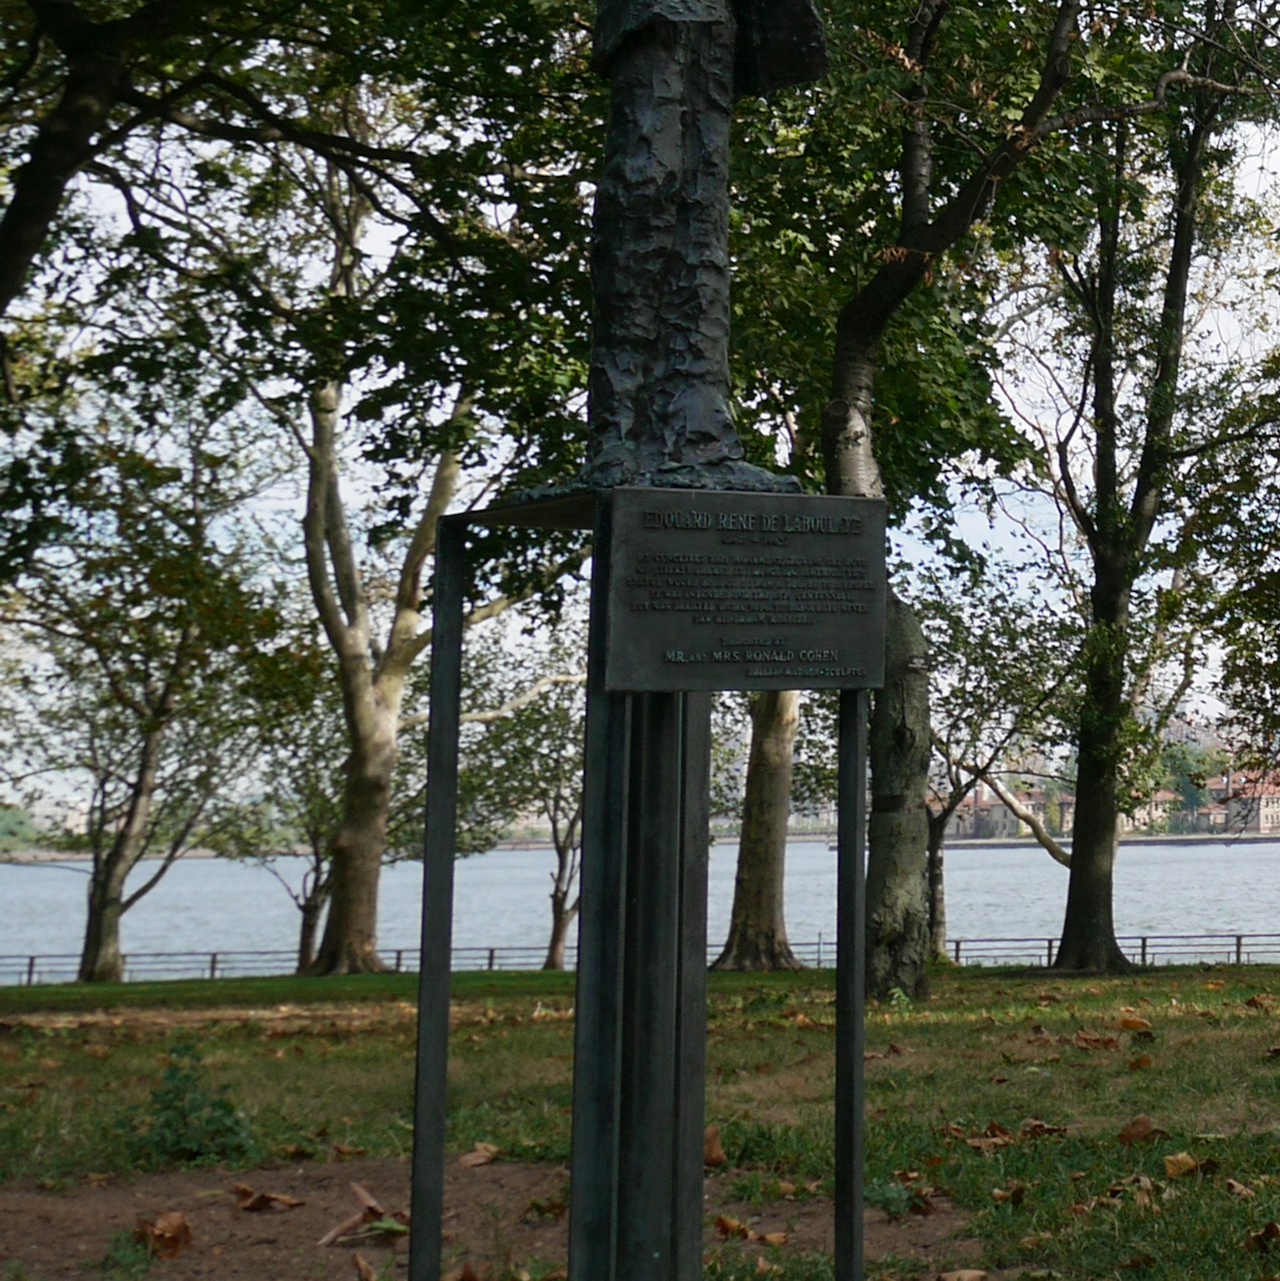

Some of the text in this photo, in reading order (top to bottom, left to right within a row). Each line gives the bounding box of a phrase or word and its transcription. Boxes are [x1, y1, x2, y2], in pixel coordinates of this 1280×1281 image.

[643, 509, 713, 530] EDOUARD
[760, 513, 780, 533] DE
[782, 514, 862, 536] LABOULAYE
[665, 649, 688, 663] MR.
[744, 649, 796, 663] RONALD
[798, 649, 839, 663] COHEN
